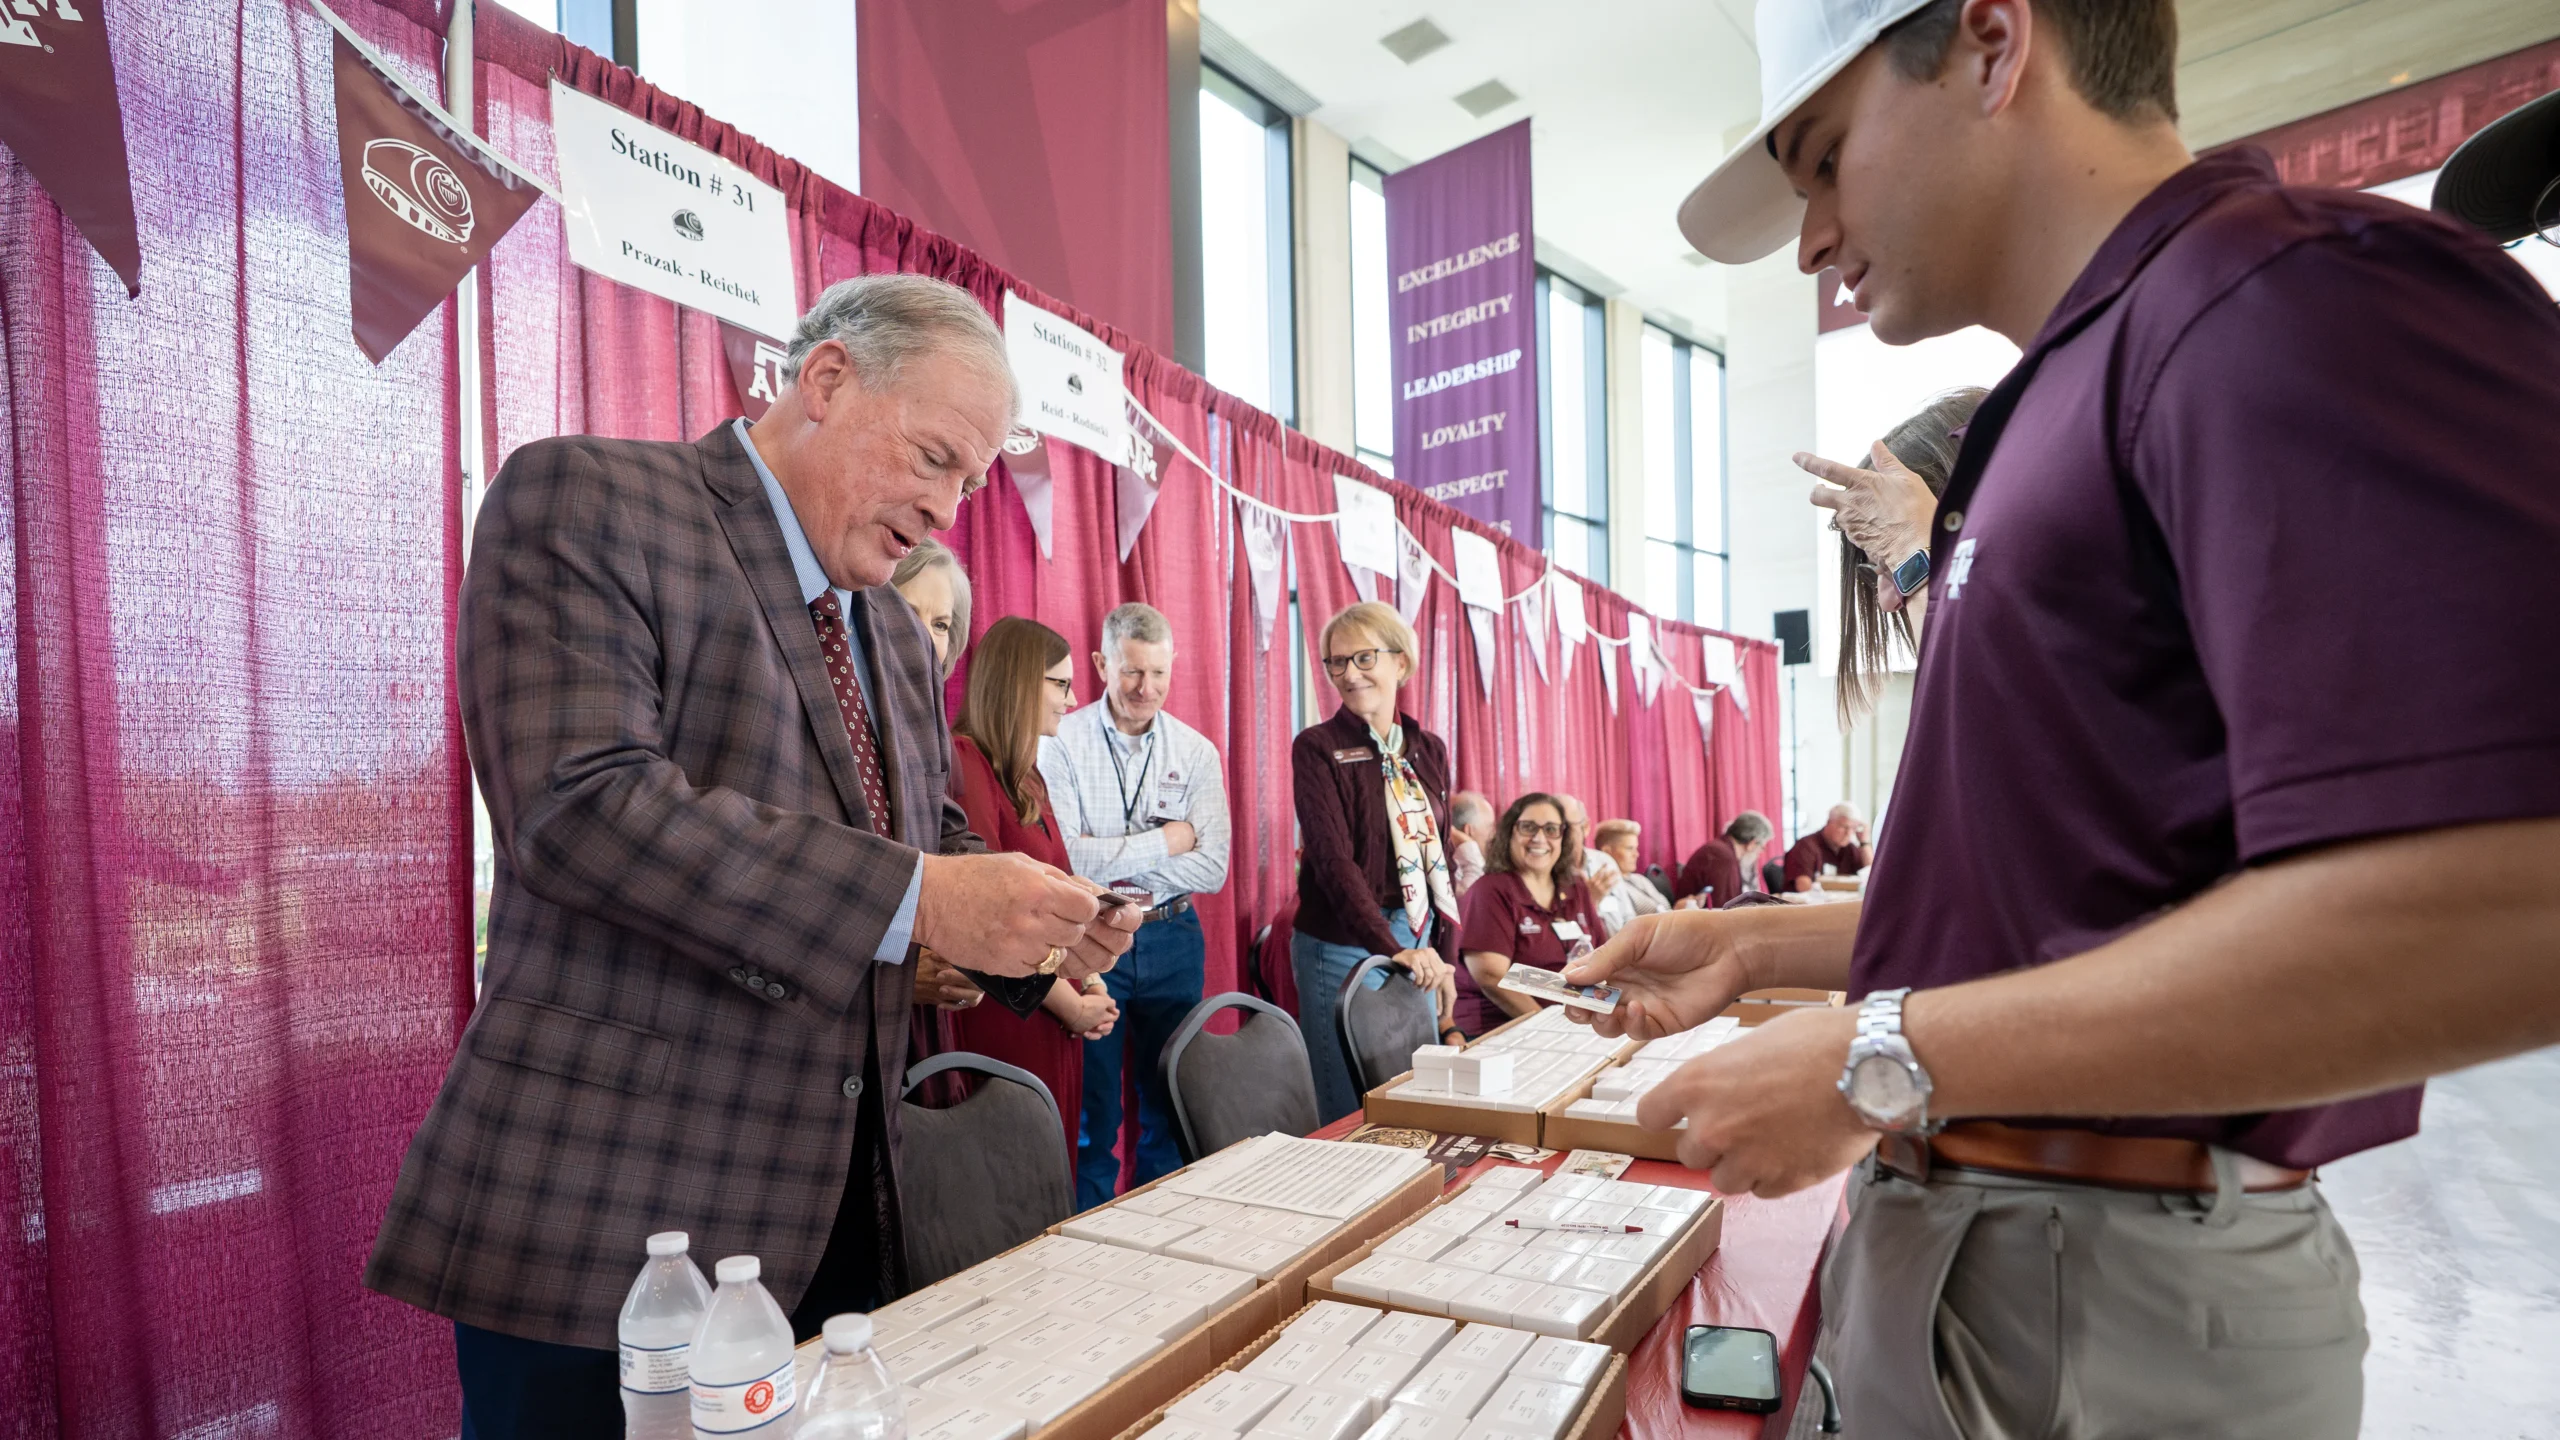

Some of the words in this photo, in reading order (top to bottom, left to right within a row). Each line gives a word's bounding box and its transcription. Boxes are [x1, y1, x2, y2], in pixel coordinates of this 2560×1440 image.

[611, 127, 702, 190] Station
[709, 173, 724, 197] #
[732, 184, 755, 214] 31
[621, 239, 683, 278] Prazak
[700, 268, 761, 307] Reichek
[1398, 232, 1521, 293] EXCELLENCE
[1407, 293, 1513, 344] INTEGRITY
[1033, 321, 1082, 357] Station
[1085, 347, 1092, 362] #
[1096, 352, 1108, 372] 32
[1403, 348, 1522, 400] LEADERSHIP
[1041, 400, 1063, 418] Reid
[1422, 411, 1507, 450] LOYALTY
